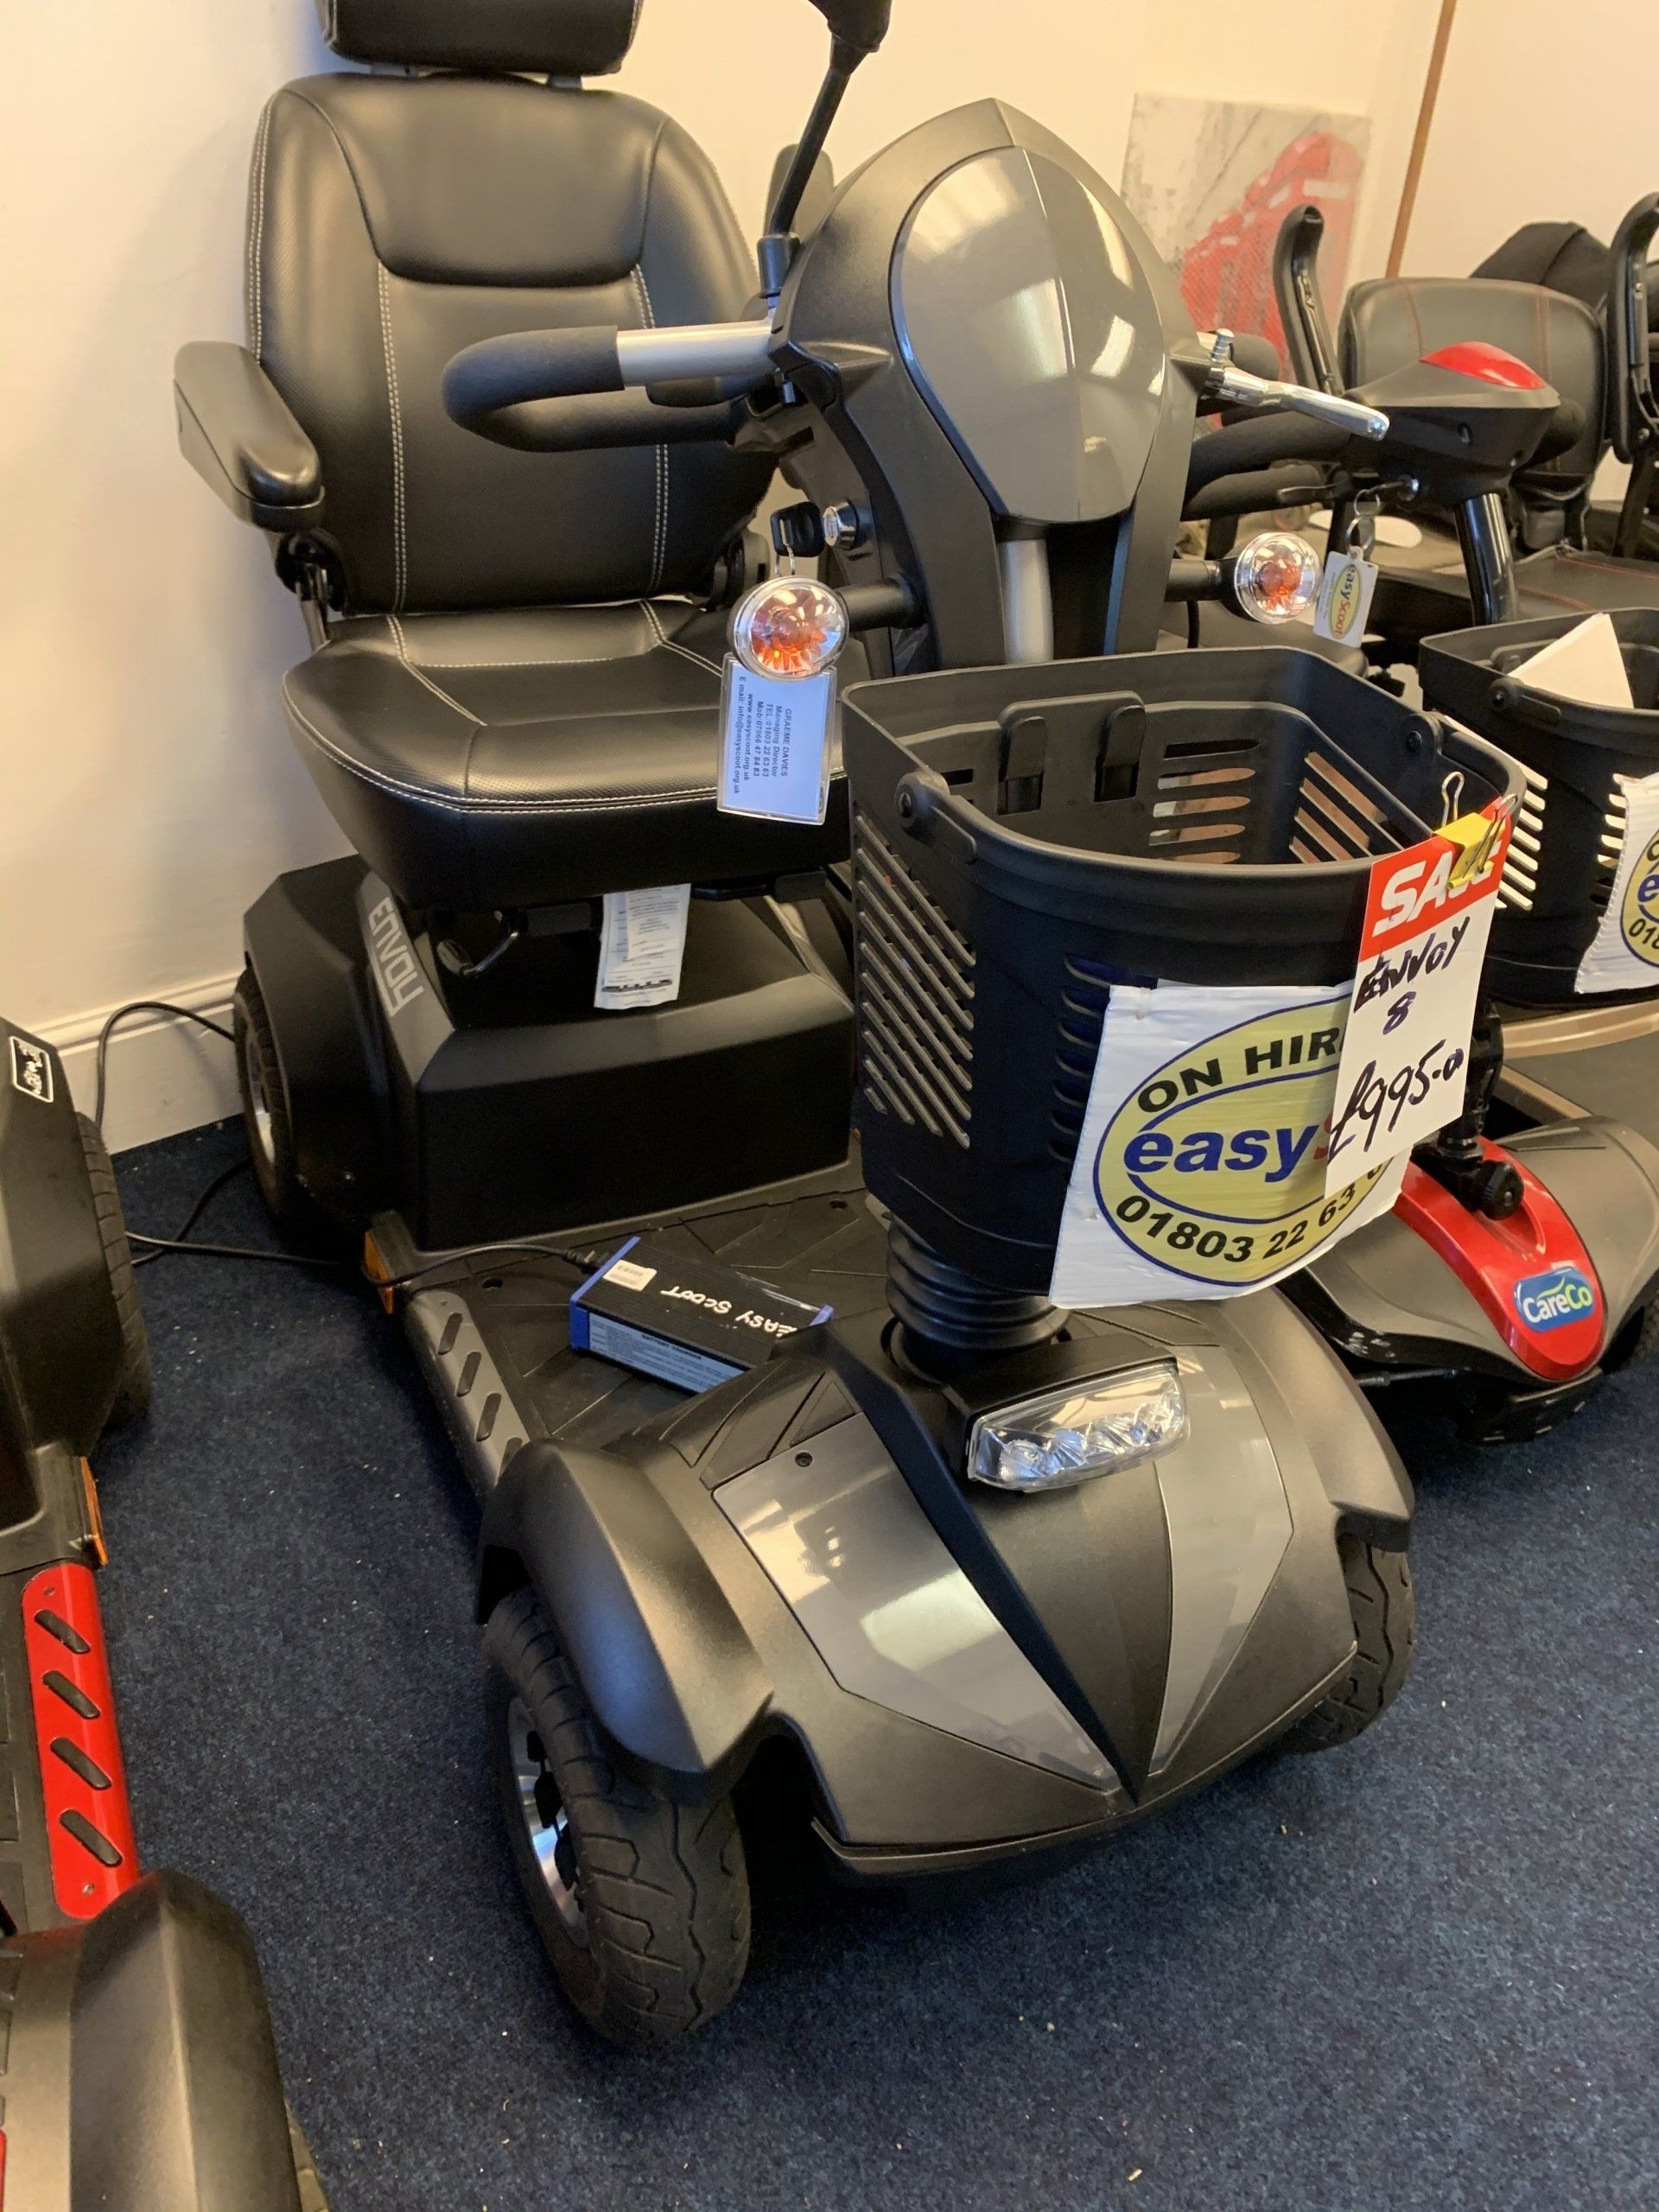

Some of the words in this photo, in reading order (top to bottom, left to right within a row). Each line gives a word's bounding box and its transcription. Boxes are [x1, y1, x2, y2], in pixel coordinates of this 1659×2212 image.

[772, 705, 783, 744] Managing
[782, 708, 792, 744] GRAEME
[753, 745, 761, 754] 47
[763, 746, 771, 755] 22
[771, 747, 780, 778] Director
[780, 747, 790, 777] DAVIES
[1382, 991, 1417, 1035] 8
[1137, 1058, 1224, 1113] ON
[1244, 1023, 1346, 1077] HIR
[1116, 1195, 1255, 1263] 01803
[1262, 1219, 1309, 1260] 22
[1318, 1182, 1356, 1227] 63
[1522, 1282, 1593, 1323] CareCo
[735, 1310, 798, 1338] EASY
